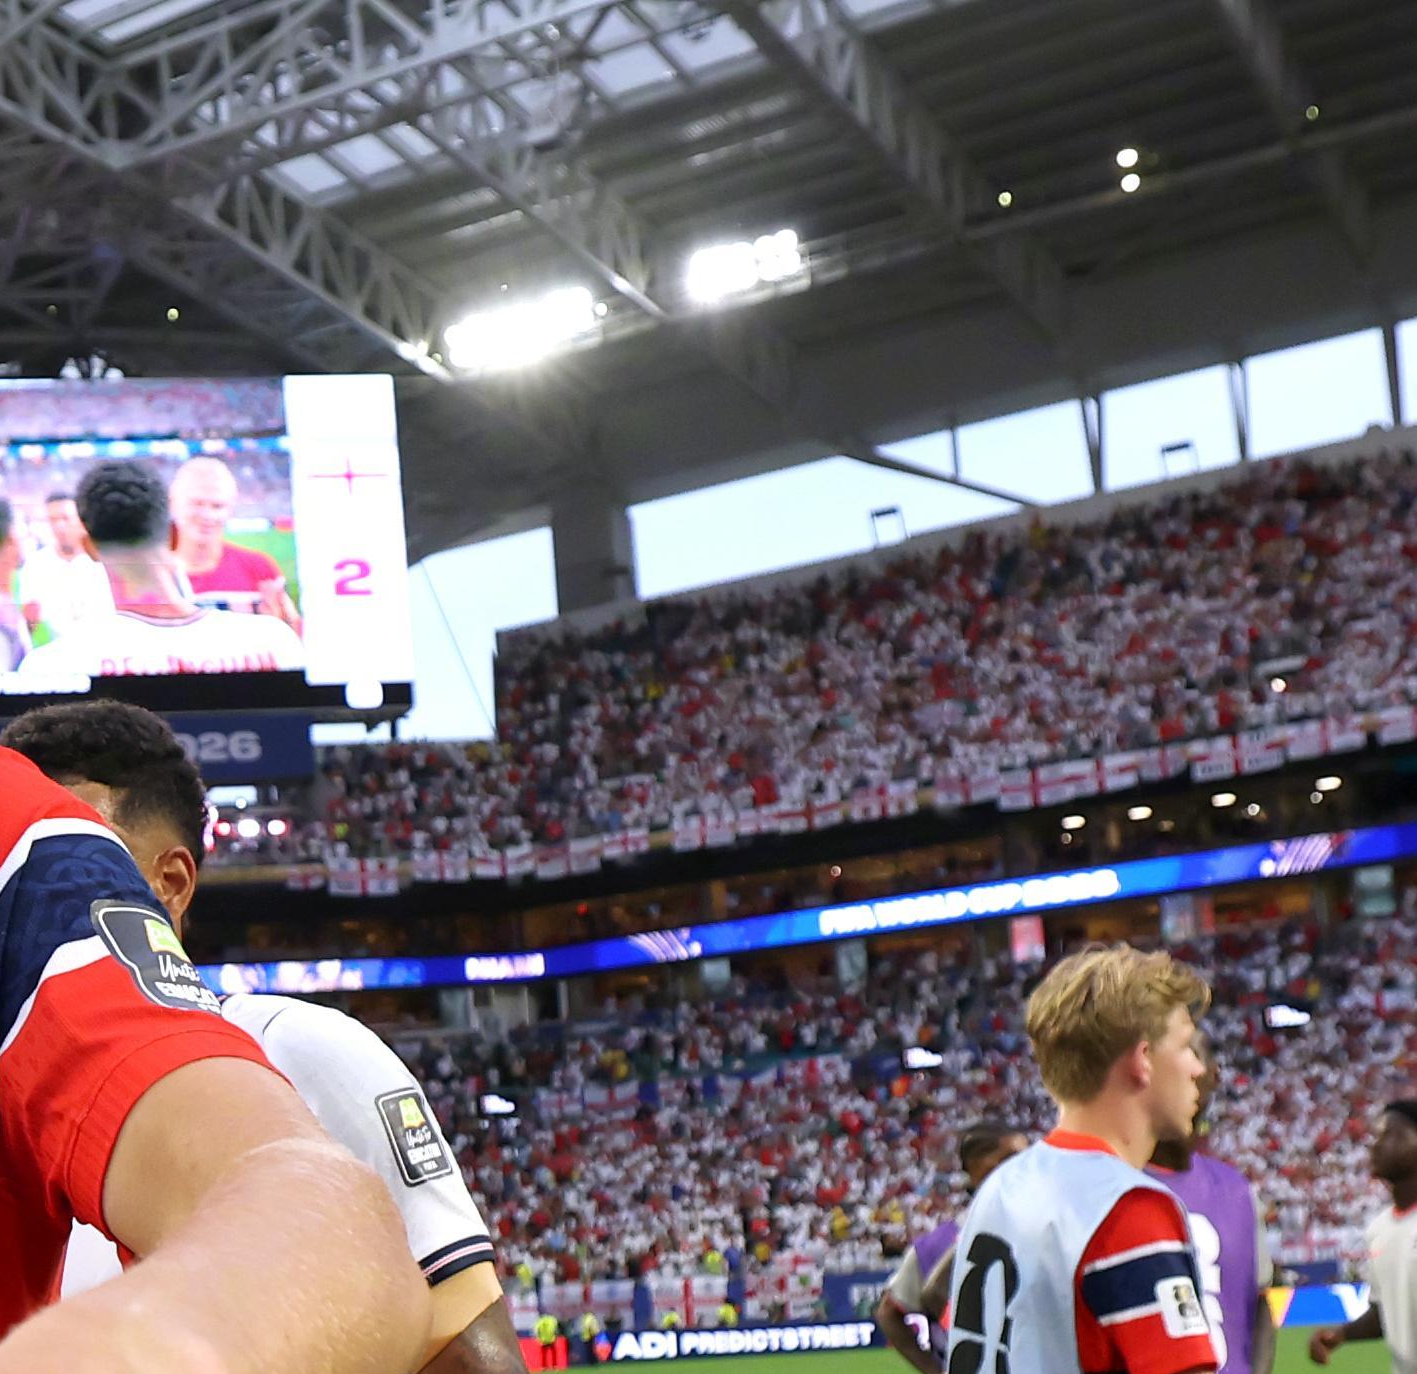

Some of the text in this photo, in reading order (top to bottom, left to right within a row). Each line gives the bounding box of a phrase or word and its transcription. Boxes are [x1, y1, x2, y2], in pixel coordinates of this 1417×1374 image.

[333, 558, 373, 596] 2
[612, 1322, 875, 1361] ADI PREDICTSTREET
